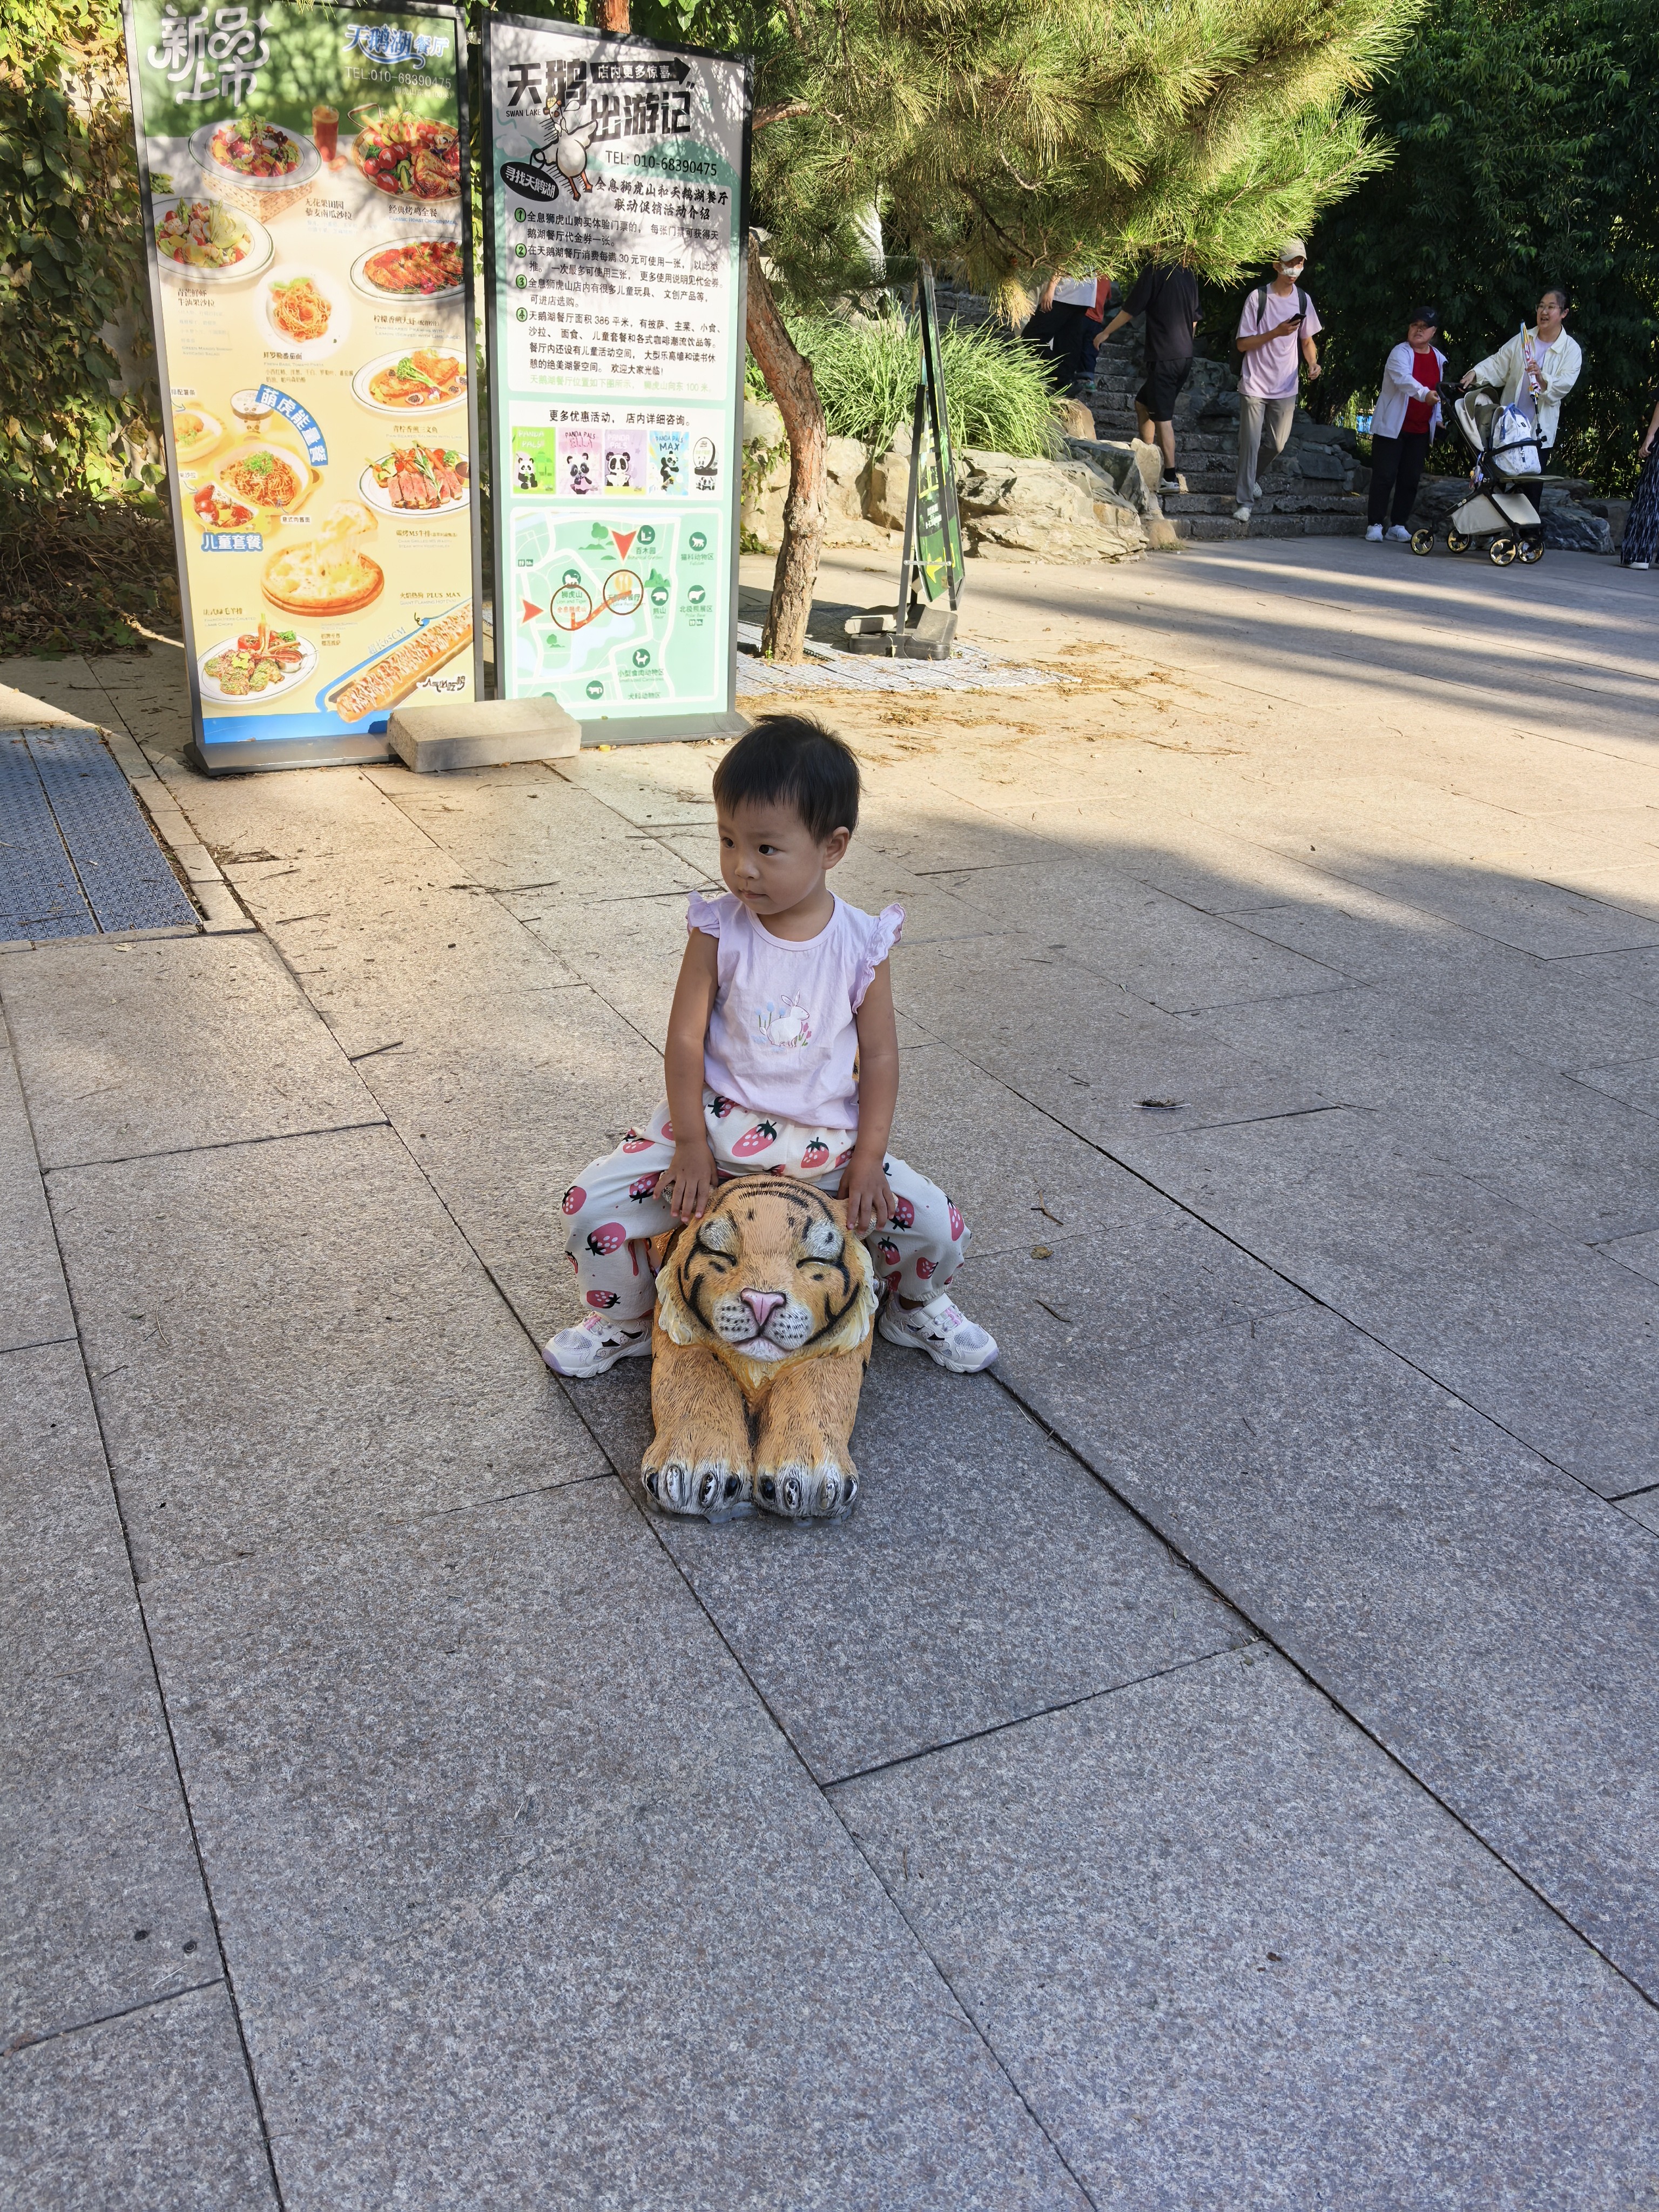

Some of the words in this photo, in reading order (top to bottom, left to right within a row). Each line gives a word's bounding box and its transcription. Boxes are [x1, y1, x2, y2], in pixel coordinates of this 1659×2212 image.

[148, 5, 271, 81] 新品
[345, 24, 450, 62] 天鹅湖餐厅
[345, 66, 452, 90] TEL:010-68390475
[597, 64, 671, 80] 店内更多惊喜
[176, 56, 258, 107] 上市
[507, 58, 588, 108] 天鹅
[505, 109, 524, 118] SWAN
[525, 108, 542, 117] LAKE
[590, 90, 691, 143] 出游记
[605, 150, 630, 166] TEL:
[633, 154, 718, 177] 010-68390475
[504, 166, 557, 199] 寻找天鹅湖
[594, 177, 730, 206] 全息狮虎山和天鹅湖餐厅
[306, 198, 344, 210] 无花果田园
[388, 204, 438, 218] 经典烤鸡全餐
[613, 197, 711, 221] 联动促销活动介绍
[650, 223, 719, 240] 每张门票可获得天
[528, 244, 617, 263] 在天鹅湖餐厅消费每满
[618, 253, 630, 264] 30
[693, 260, 719, 272] 以此类
[178, 298, 215, 307] 牛油果沙拉
[528, 309, 592, 326] 天鹅湖餐厅面积
[594, 315, 610, 326] 386
[260, 388, 327, 463] 萌虎能量餐
[549, 409, 616, 424] 更多优惠活动，
[625, 412, 692, 427] 店内详细咨询。
[517, 429, 545, 438] PANDA
[564, 430, 583, 439] PANDA
[583, 431, 596, 440] PALS
[607, 433, 630, 442] PANDA
[655, 434, 673, 442] PANDA
[673, 435, 684, 443] PALS
[521, 439, 543, 449] PALS
[610, 441, 628, 449] PALS
[659, 442, 680, 452] MAX
[204, 534, 262, 550] 儿童套餐
[561, 590, 583, 599] 狮虎山
[367, 626, 407, 655] 超长65CM
[617, 668, 664, 678] 小型食肉动物区
